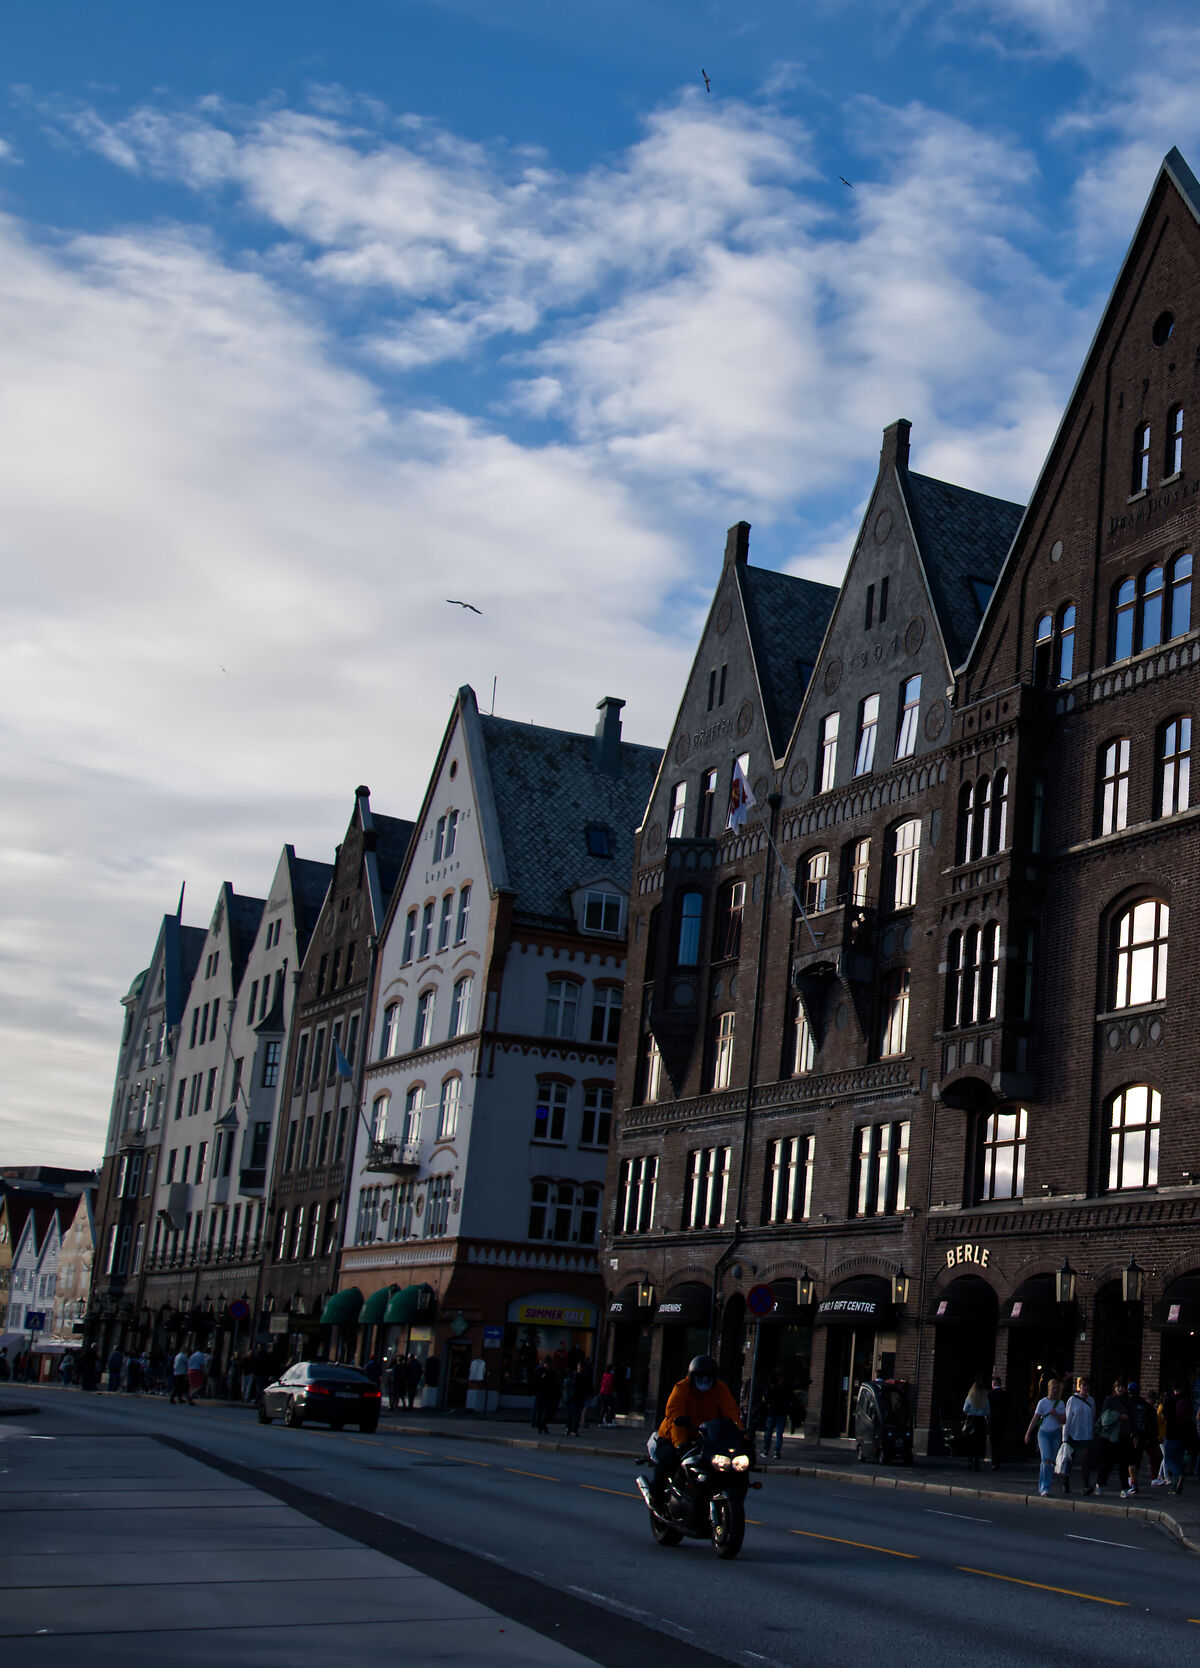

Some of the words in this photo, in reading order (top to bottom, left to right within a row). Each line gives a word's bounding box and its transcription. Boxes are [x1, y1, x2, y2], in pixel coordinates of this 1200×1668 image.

[946, 1243, 990, 1269] BERLE
[834, 1300, 848, 1310] GIFT
[847, 1301, 876, 1313] CENTRE
[525, 1308, 563, 1320] SUMMER
